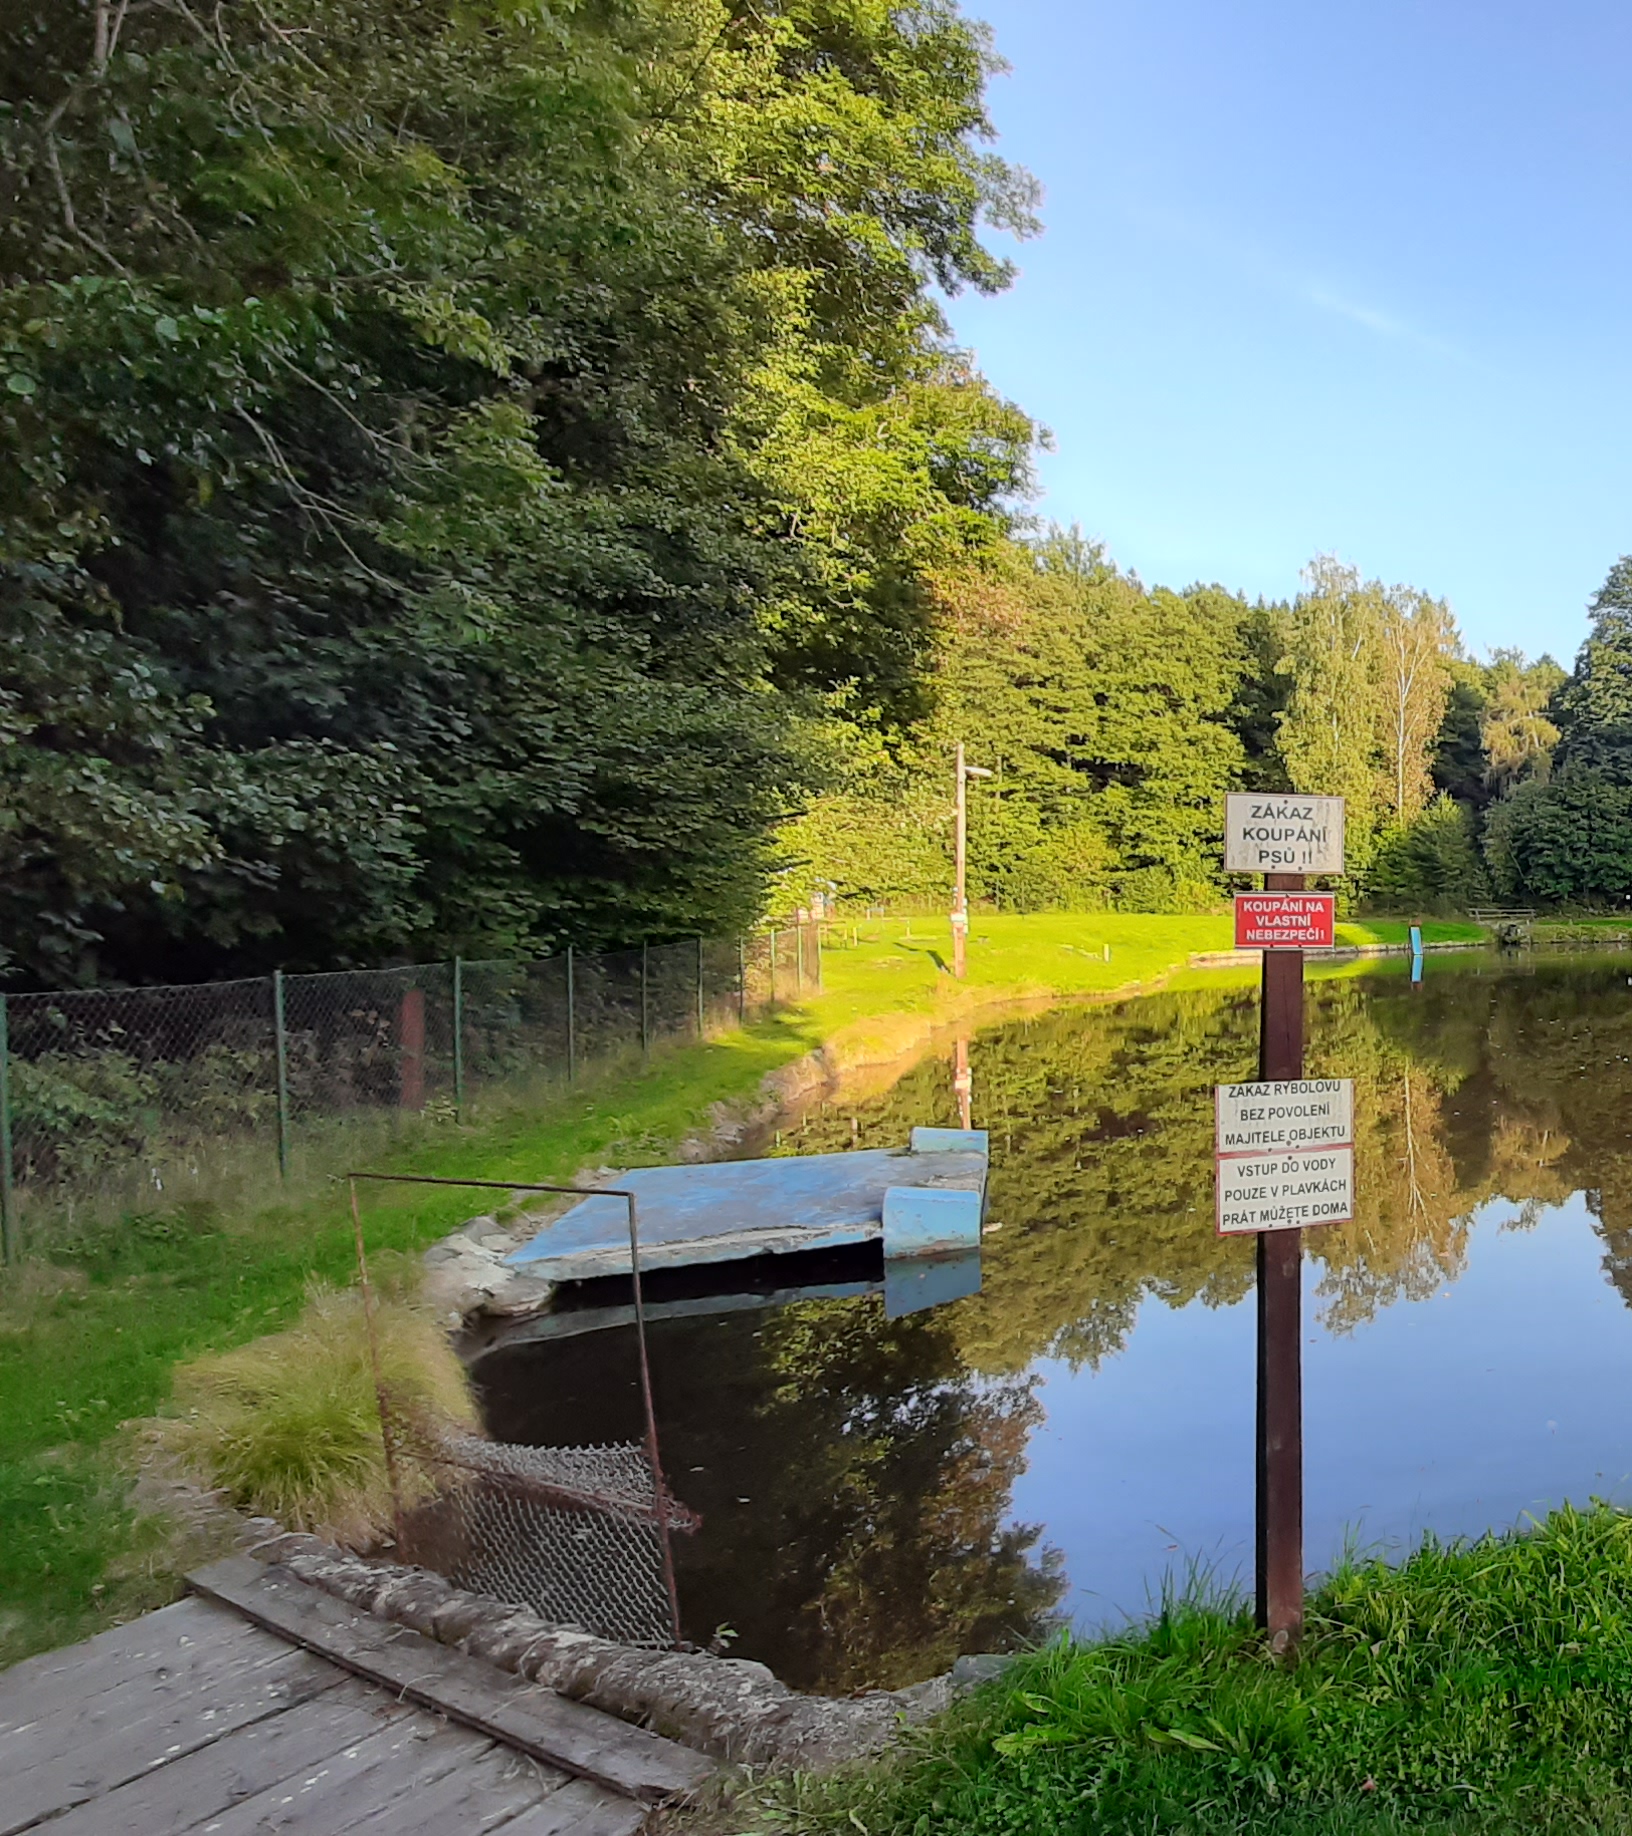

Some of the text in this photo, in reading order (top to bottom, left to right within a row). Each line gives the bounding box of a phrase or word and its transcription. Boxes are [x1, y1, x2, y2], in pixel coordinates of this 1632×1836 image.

[1251, 802, 1313, 820] ZÁKAZ
[1242, 825, 1327, 842] KOUPÁNÍ
[1259, 847, 1295, 864] PSŮ
[1243, 900, 1324, 912] KOUPÁNÍ NA
[1256, 914, 1311, 926] VLASTNÍ
[1240, 1102, 1330, 1121] BEZ POVOLENÍ
[1225, 1125, 1345, 1145] MAJITELE OBJEKTU
[1237, 1158, 1336, 1177] VSTUP DO VODY
[1224, 1179, 1346, 1202] POUZE V PLAVKÁCH
[1222, 1202, 1348, 1225] PRÁT MŮŽETE DOMA
